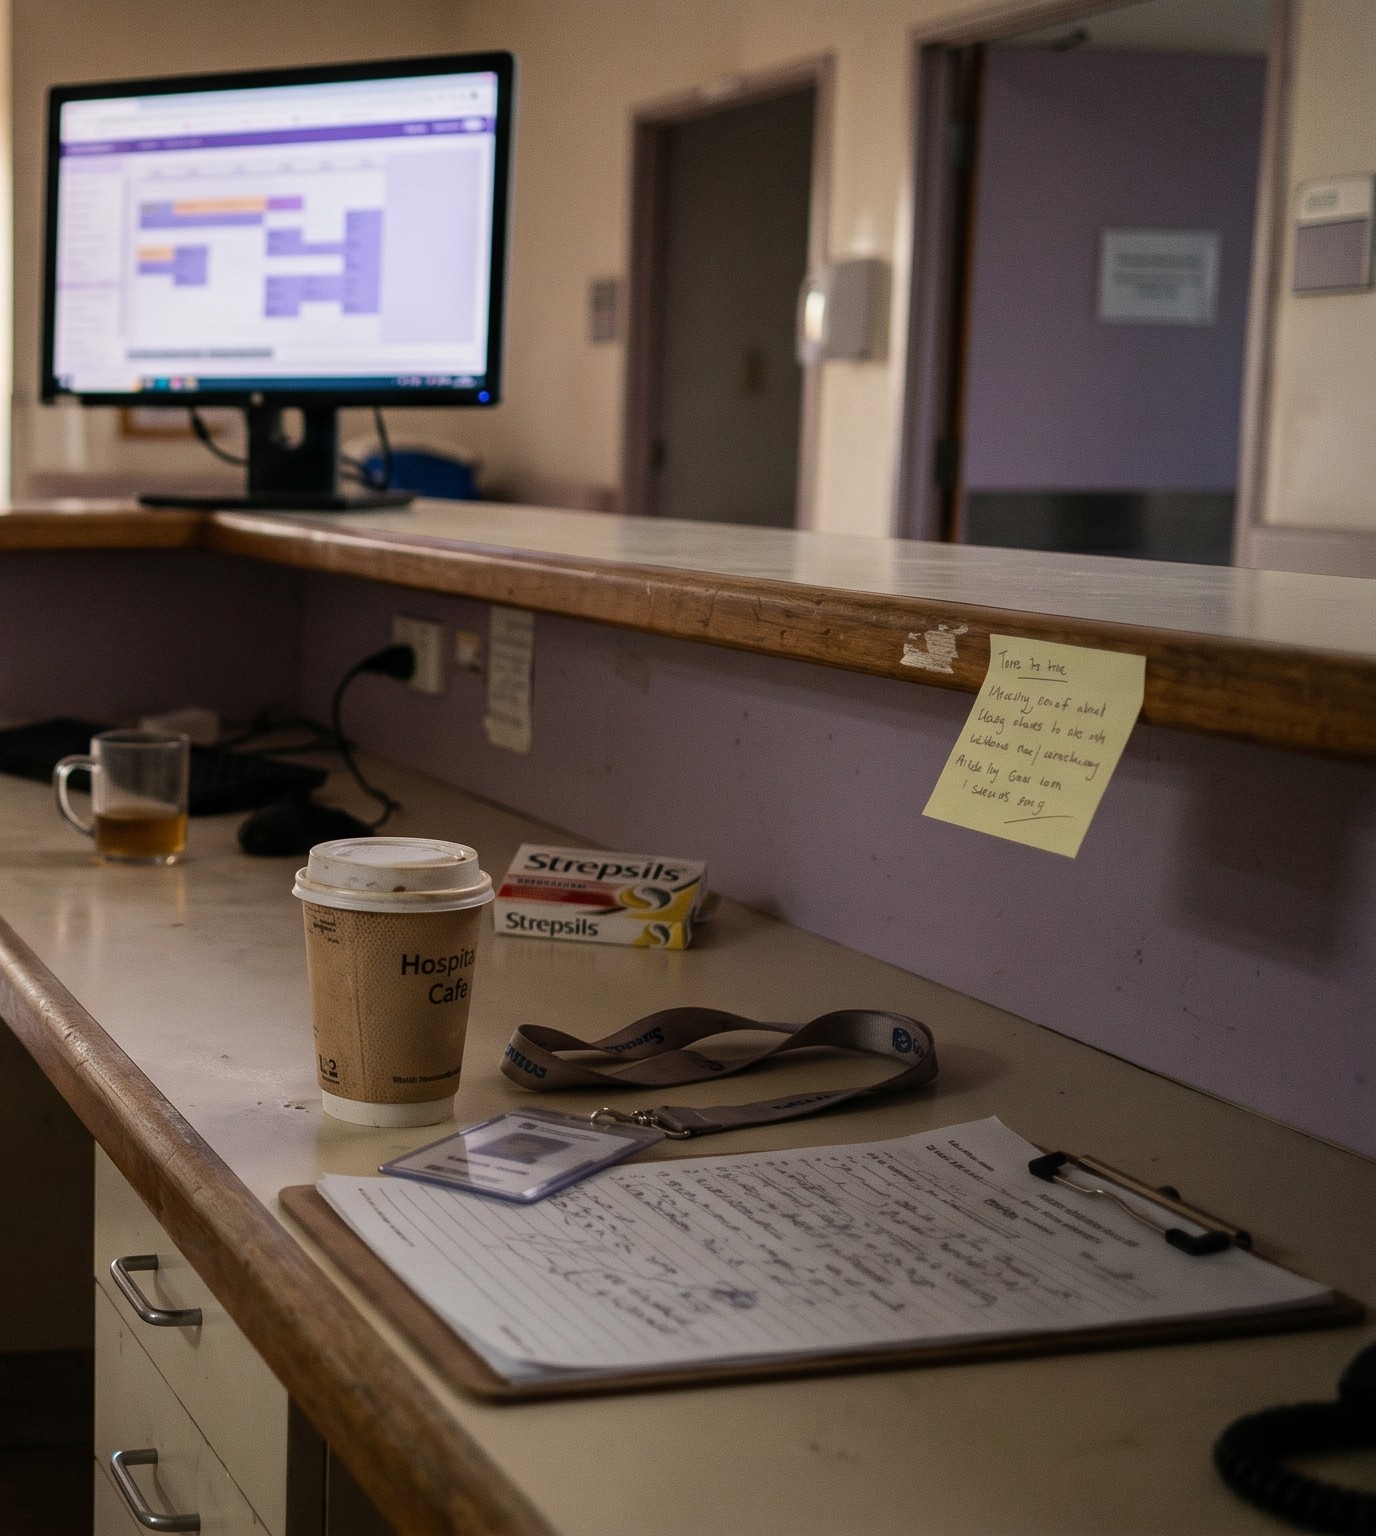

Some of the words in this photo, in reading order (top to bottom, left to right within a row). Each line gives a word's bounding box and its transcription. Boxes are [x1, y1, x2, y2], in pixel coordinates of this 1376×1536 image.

[524, 852, 681, 882] Strepsils
[506, 911, 599, 937] Strepsils
[401, 948, 475, 977] Hospita
[428, 977, 468, 1005] Cafe
